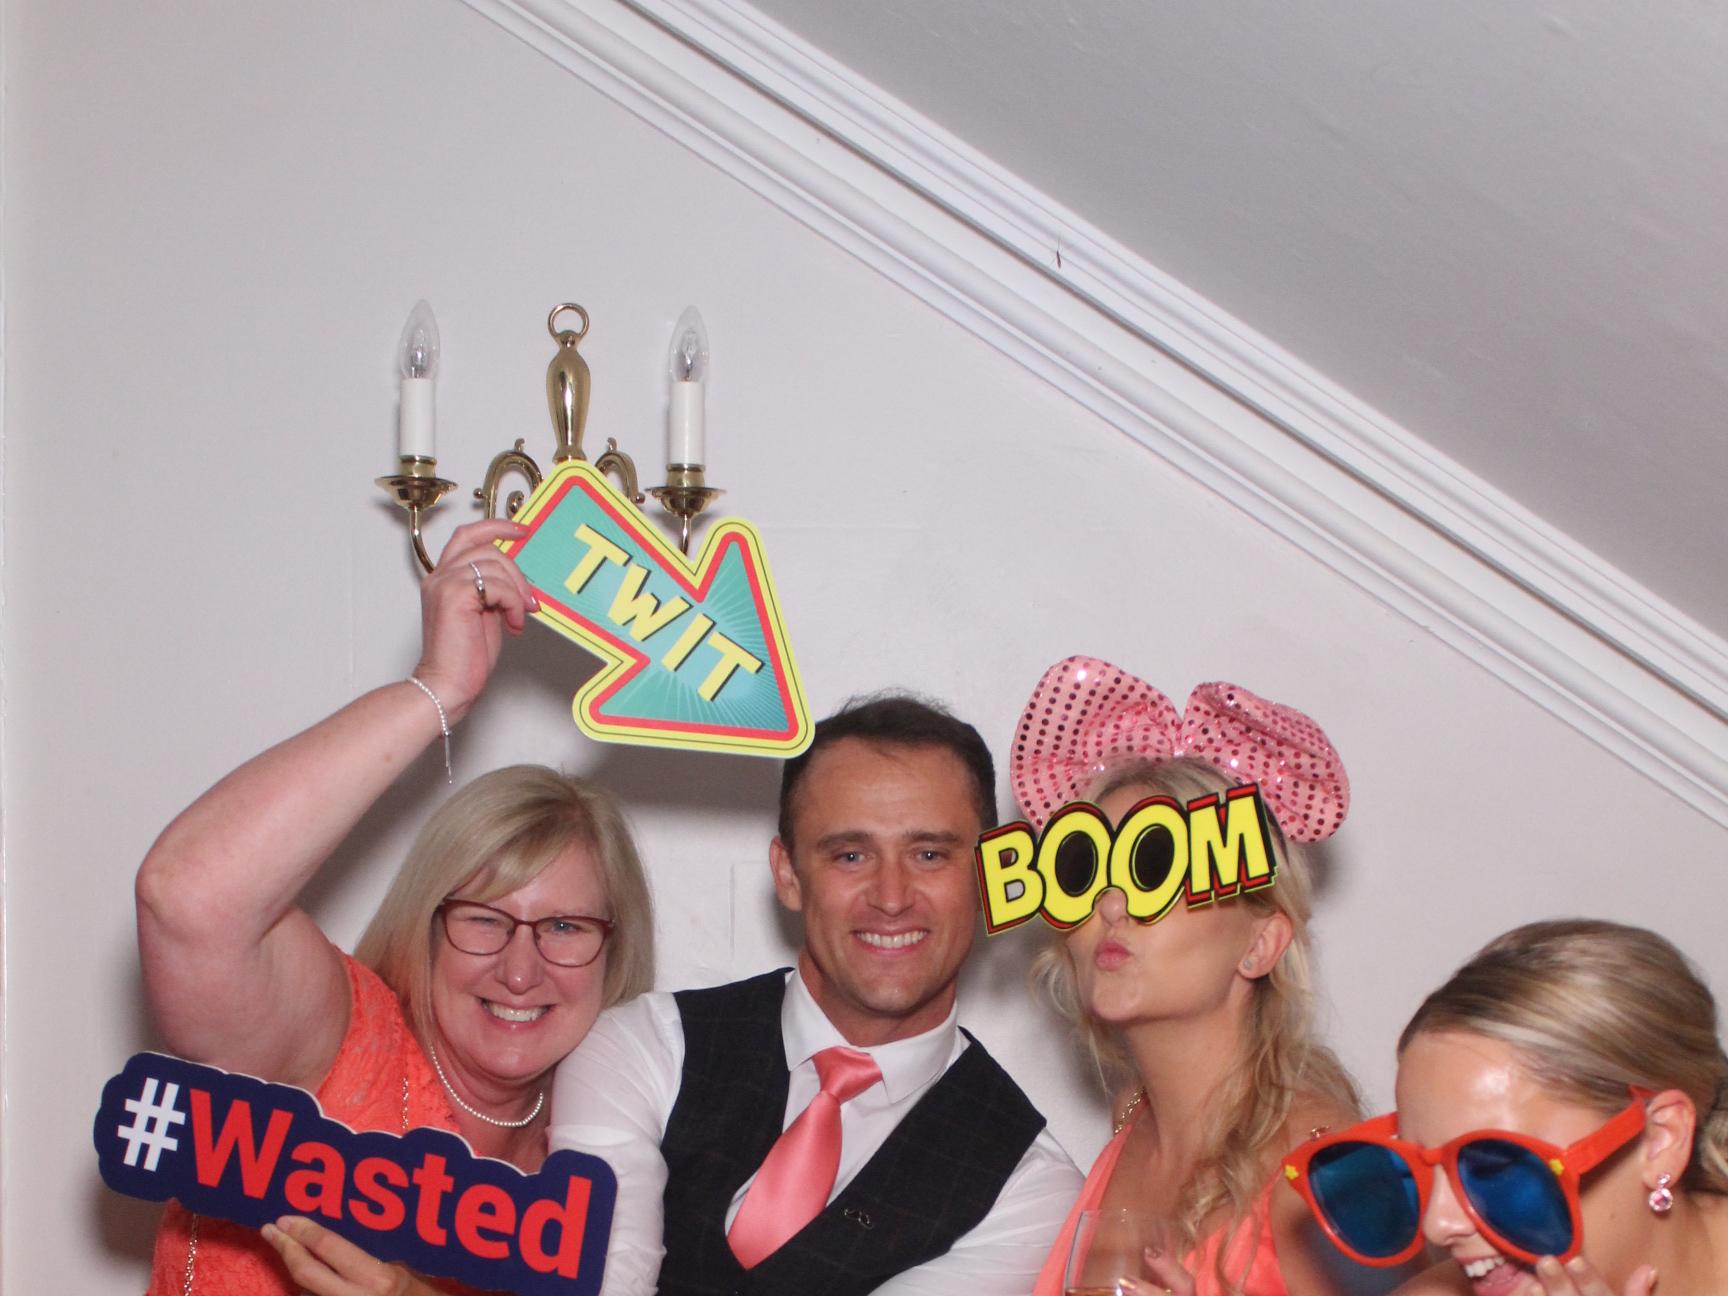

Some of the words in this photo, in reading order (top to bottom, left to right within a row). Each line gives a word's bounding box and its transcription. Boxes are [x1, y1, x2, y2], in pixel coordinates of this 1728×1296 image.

[563, 523, 765, 702] TWIT
[976, 784, 1276, 934] BOOM
[117, 1077, 592, 1280] #Wasted
